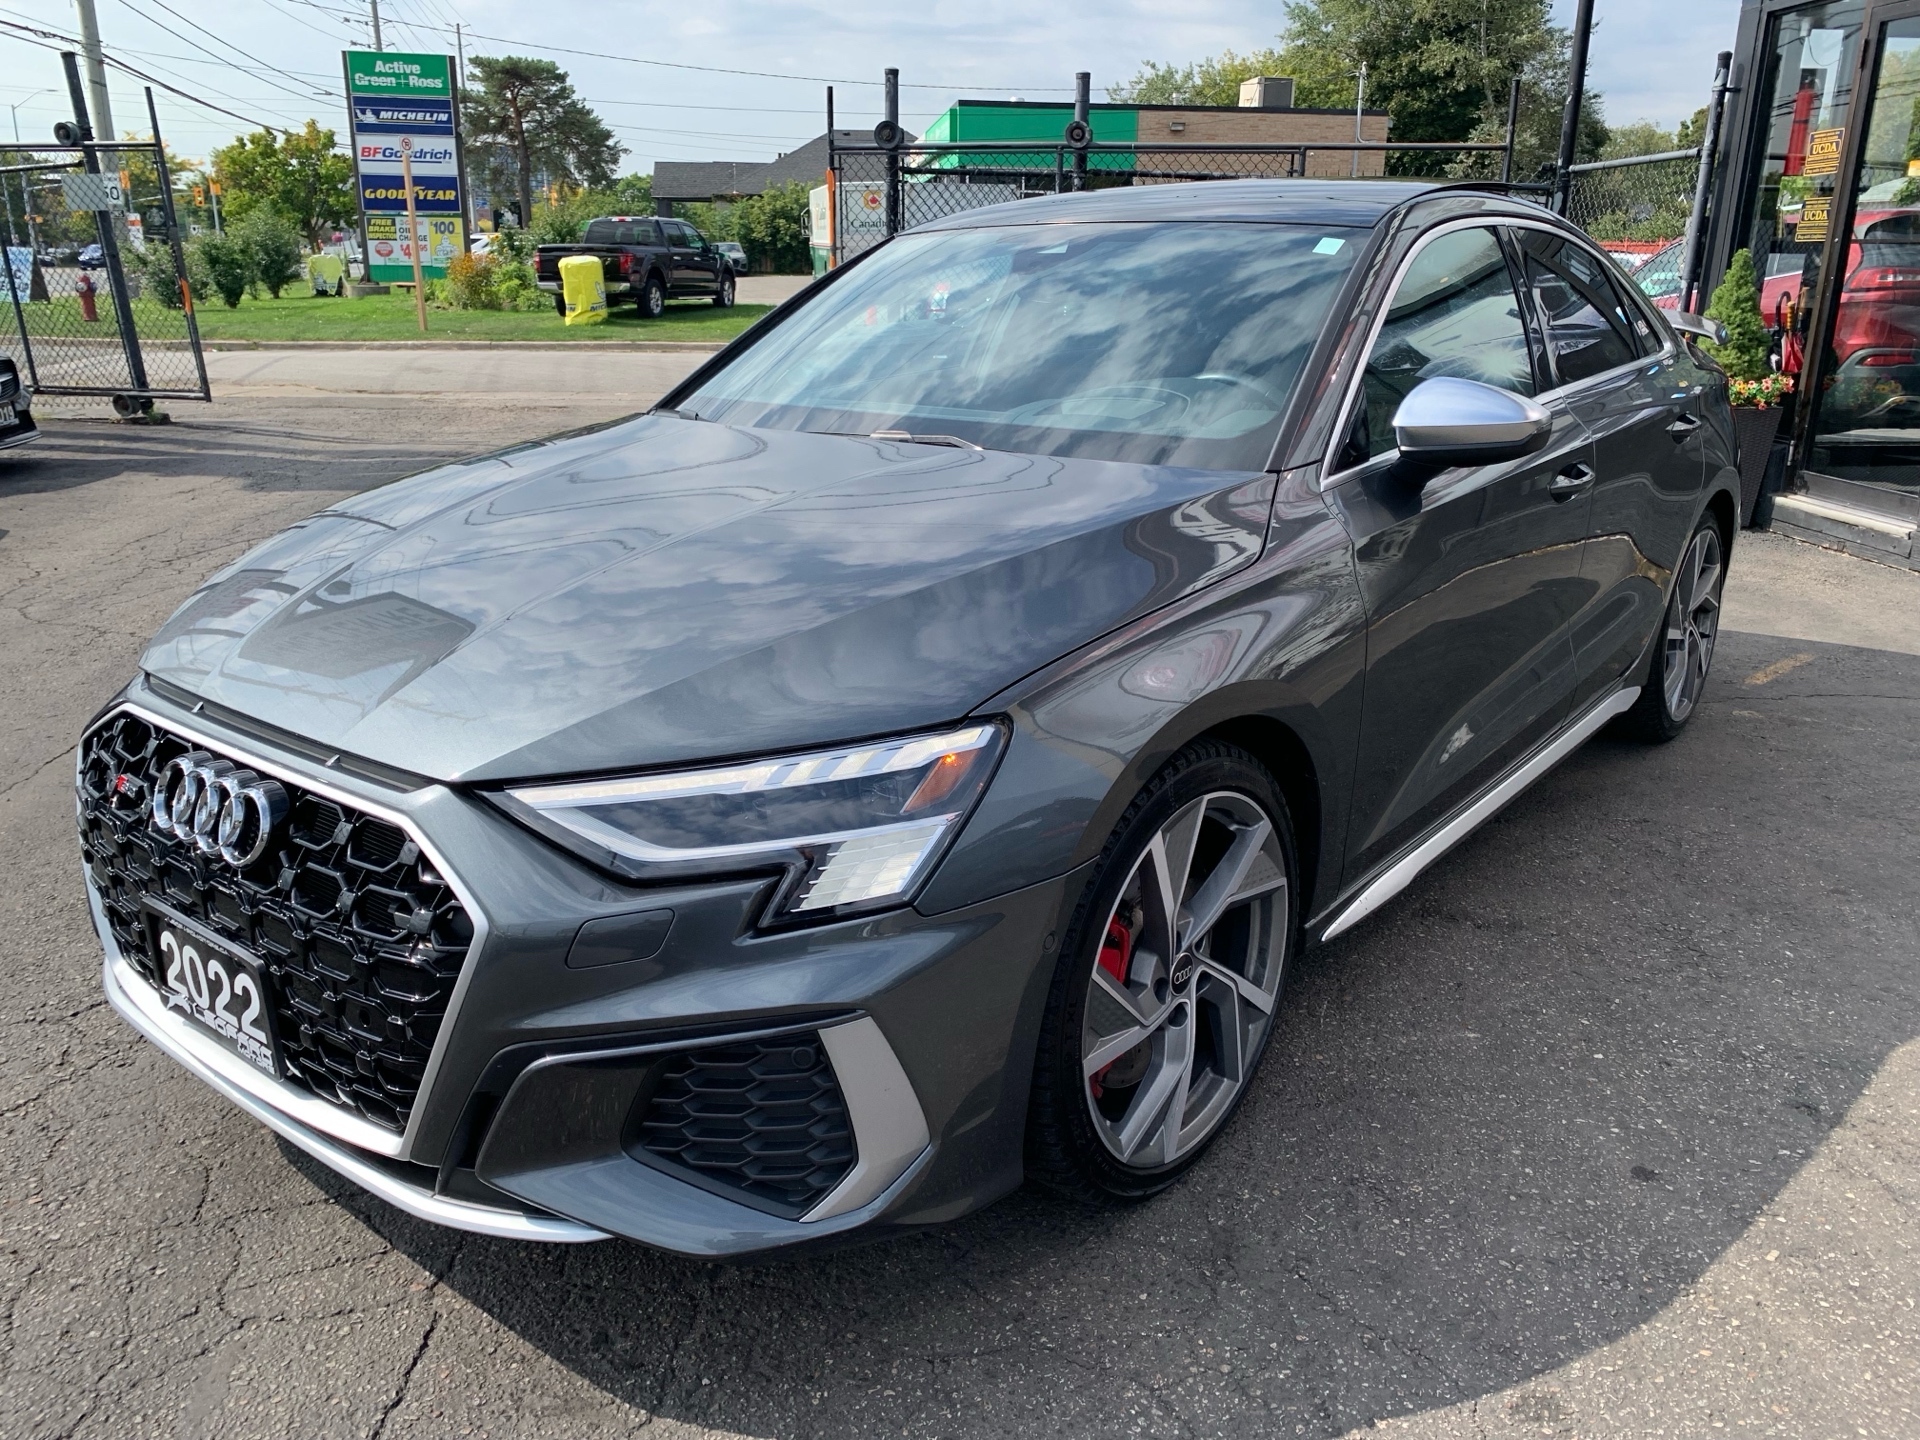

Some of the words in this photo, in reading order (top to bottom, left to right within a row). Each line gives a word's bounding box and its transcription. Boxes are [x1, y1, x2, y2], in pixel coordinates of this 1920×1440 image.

[374, 61, 421, 74] Active
[379, 111, 449, 121] MICHELIN
[360, 146, 453, 160] BFGodrich
[1812, 143, 1837, 154] UCDA
[364, 186, 456, 200] GOODYEAR
[1804, 210, 1828, 220] UCDA
[430, 221, 455, 234] $100
[160, 930, 268, 1045] 2022
